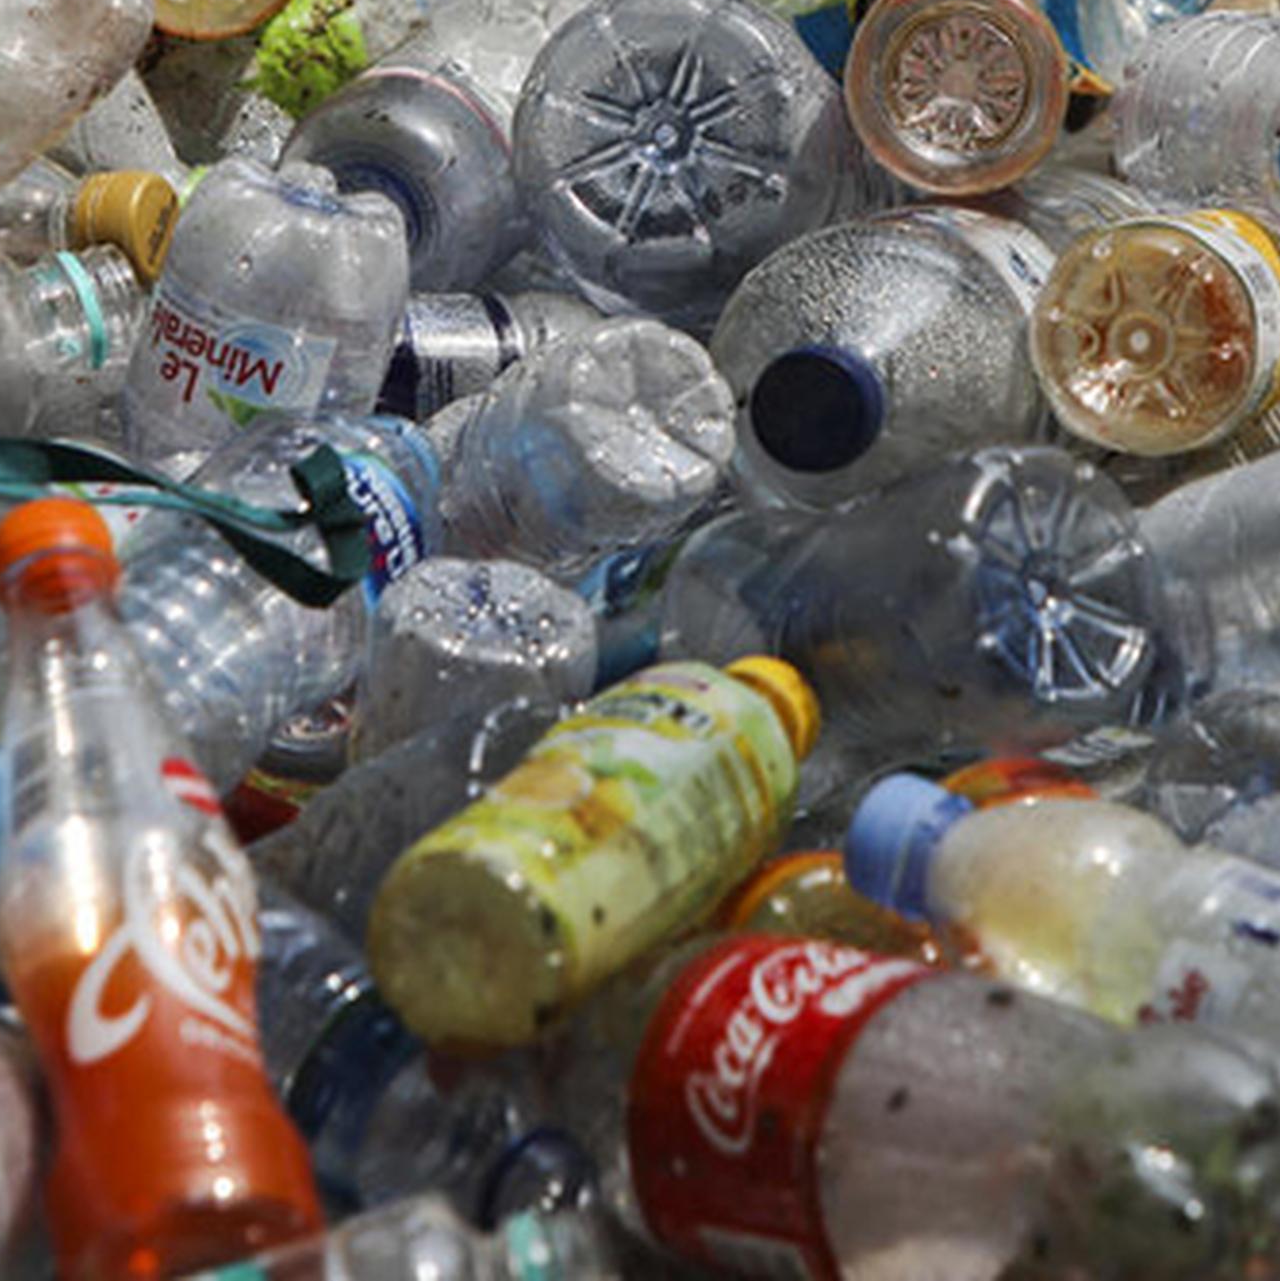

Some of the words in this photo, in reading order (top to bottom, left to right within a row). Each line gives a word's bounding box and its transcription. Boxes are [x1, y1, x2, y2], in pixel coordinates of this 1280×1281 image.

[151, 297, 285, 396] Mineral
[160, 351, 201, 404] Le
[344, 464, 394, 545] ure
